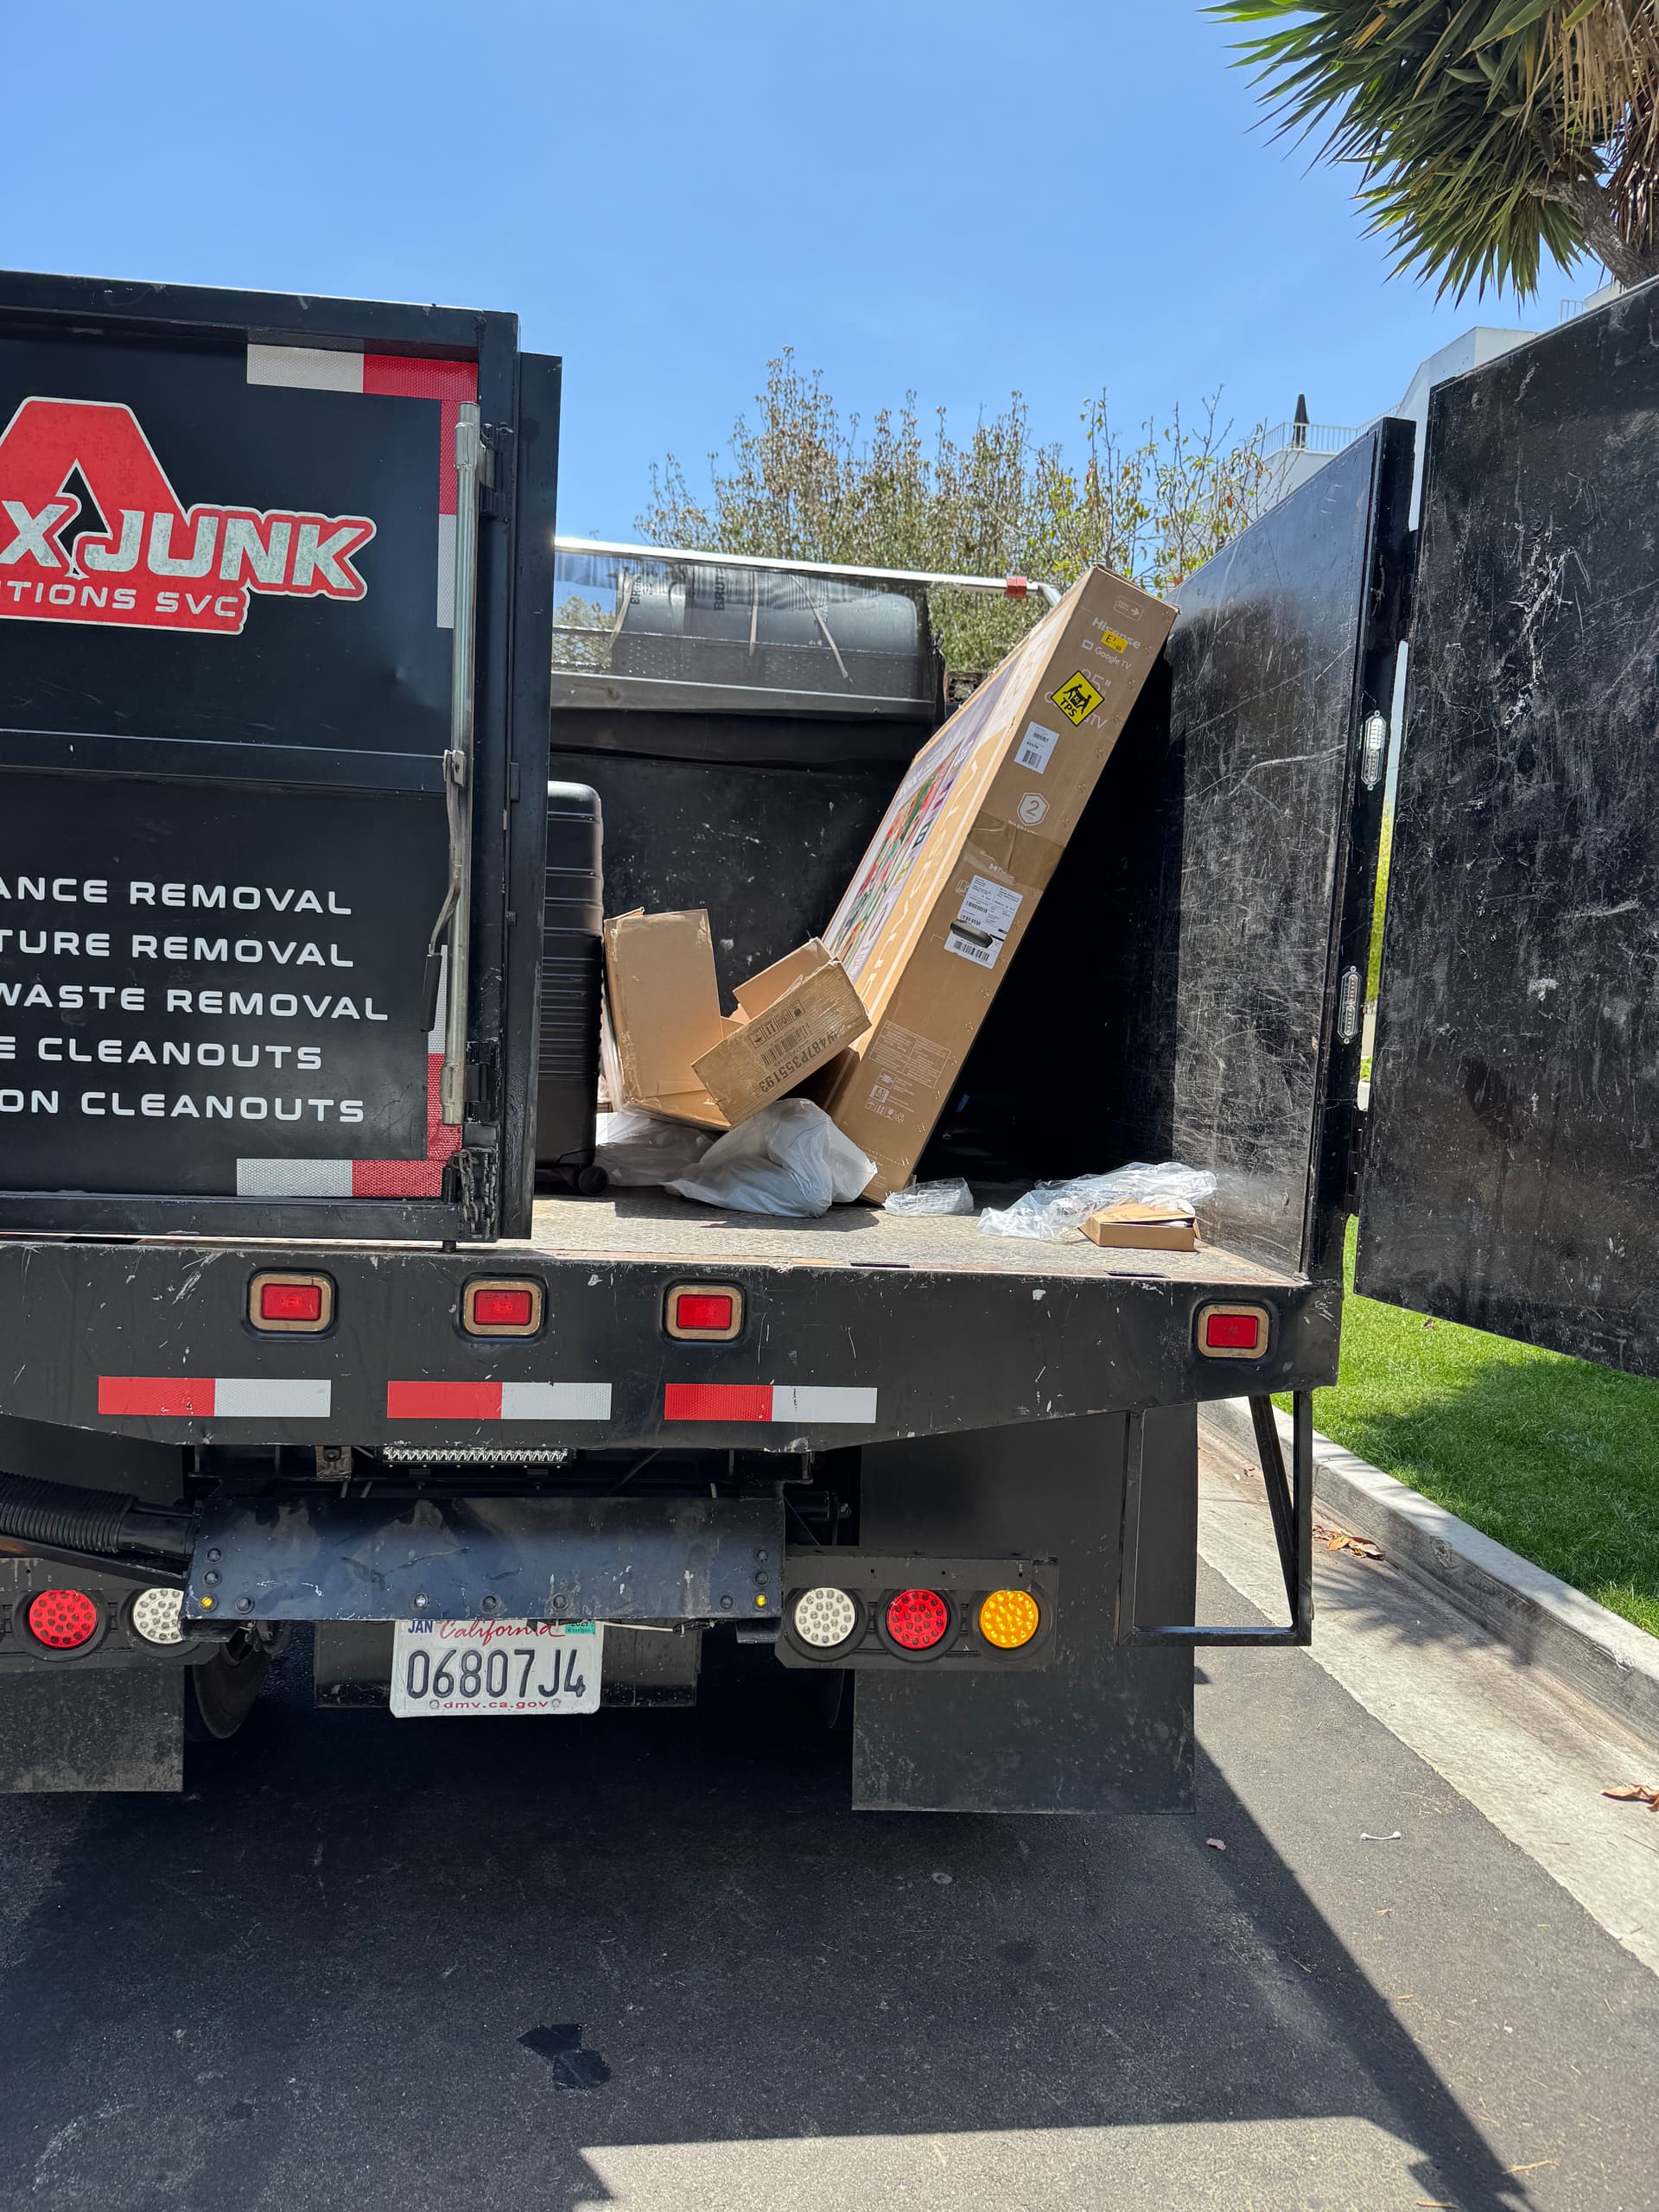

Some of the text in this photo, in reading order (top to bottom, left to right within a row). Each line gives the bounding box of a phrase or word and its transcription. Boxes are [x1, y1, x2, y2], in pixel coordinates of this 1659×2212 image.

[85, 509, 365, 589] JUNK
[0, 581, 238, 617] TIONS SVC
[1095, 646, 1121, 664] Google
[1121, 659, 1132, 671] TV
[1060, 697, 1077, 717] TPS
[1026, 800, 1039, 817] 2
[130, 880, 352, 915] REMOVAL
[859, 760, 977, 1002] anvasTV
[132, 934, 354, 968] REMOVAL
[0, 983, 388, 1021] WASTE REMOVAL
[38, 1037, 322, 1070] CLEANOUTS
[0, 1089, 364, 1123] ON CLEANOUTS
[408, 1619, 433, 1633] JAN
[440, 1619, 566, 1645] California
[406, 1649, 587, 1699] 06807J4
[443, 1700, 549, 1710] dmv.ca.gov
